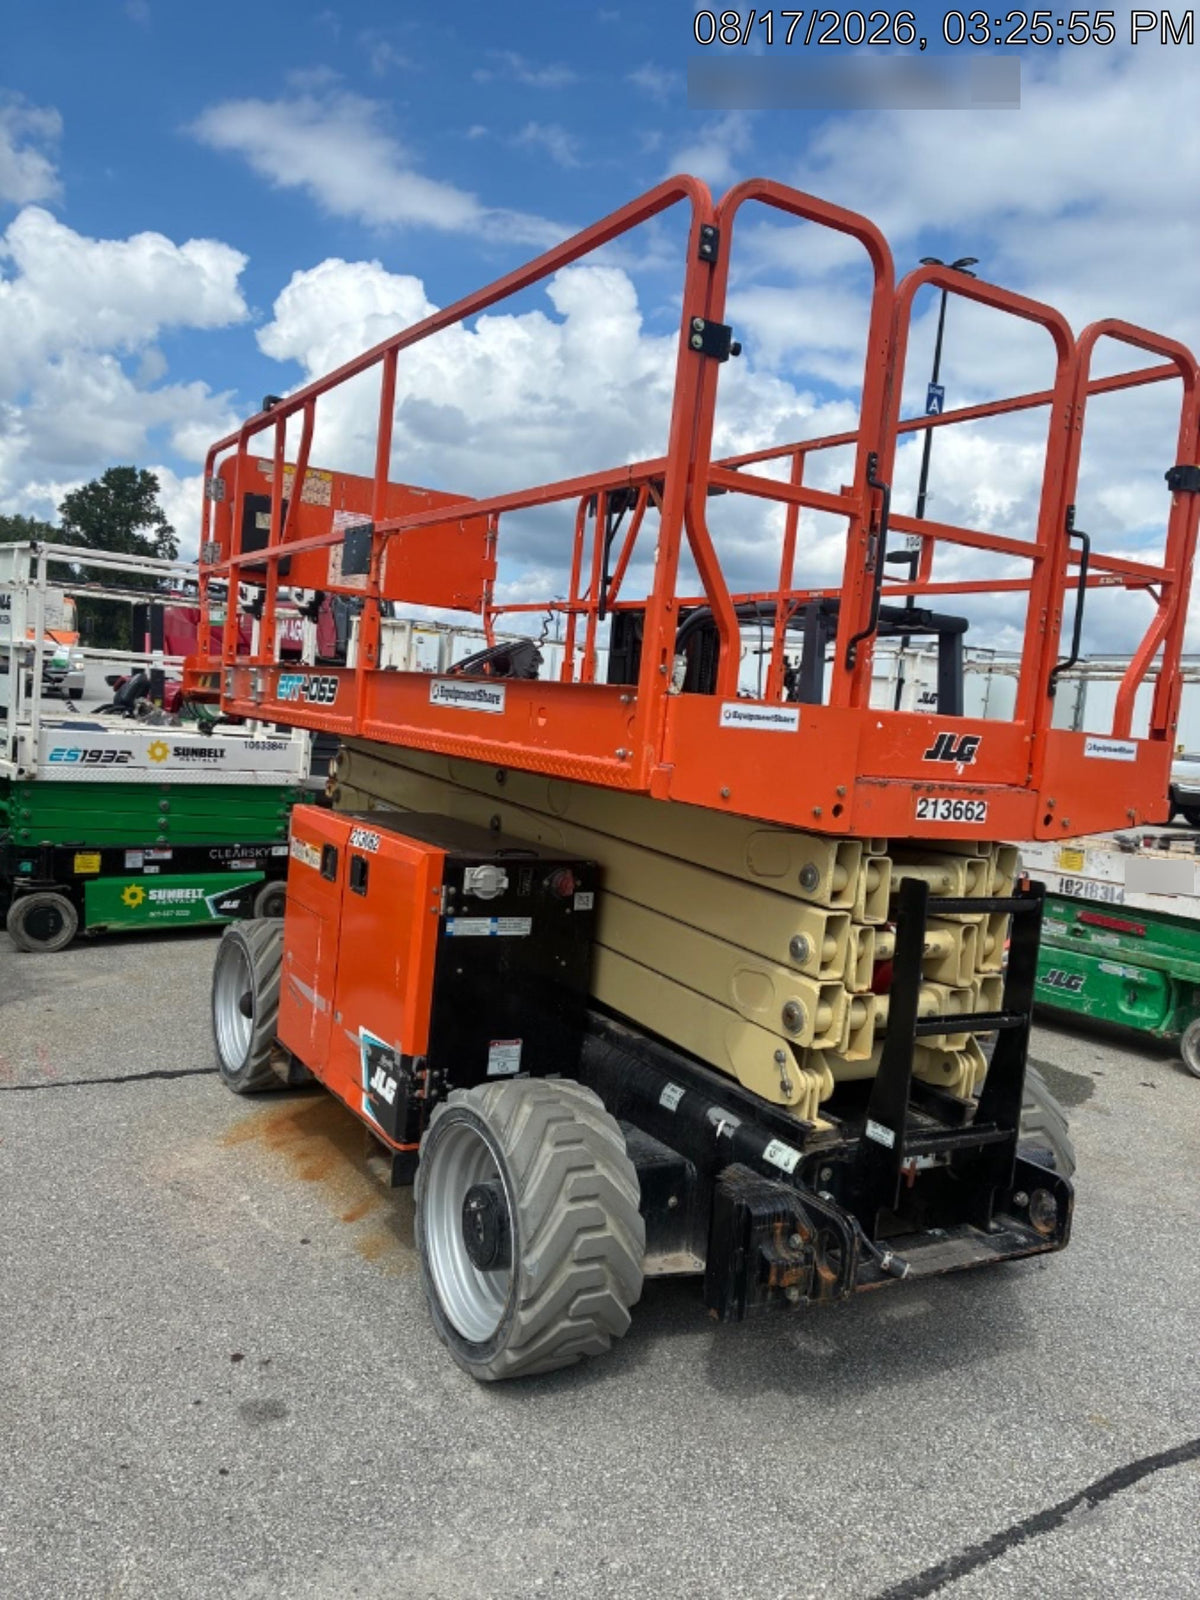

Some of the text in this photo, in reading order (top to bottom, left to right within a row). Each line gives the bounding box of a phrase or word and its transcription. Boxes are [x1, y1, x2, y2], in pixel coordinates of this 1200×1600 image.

[928, 396, 940, 414] A
[49, 747, 133, 764] ES1932
[173, 746, 226, 760] SUNBELT
[923, 732, 982, 764] JLG
[917, 798, 987, 822] 213662
[148, 888, 205, 901] SUNBELT
[1042, 968, 1086, 993] JLG
[370, 1066, 397, 1105] JLG
